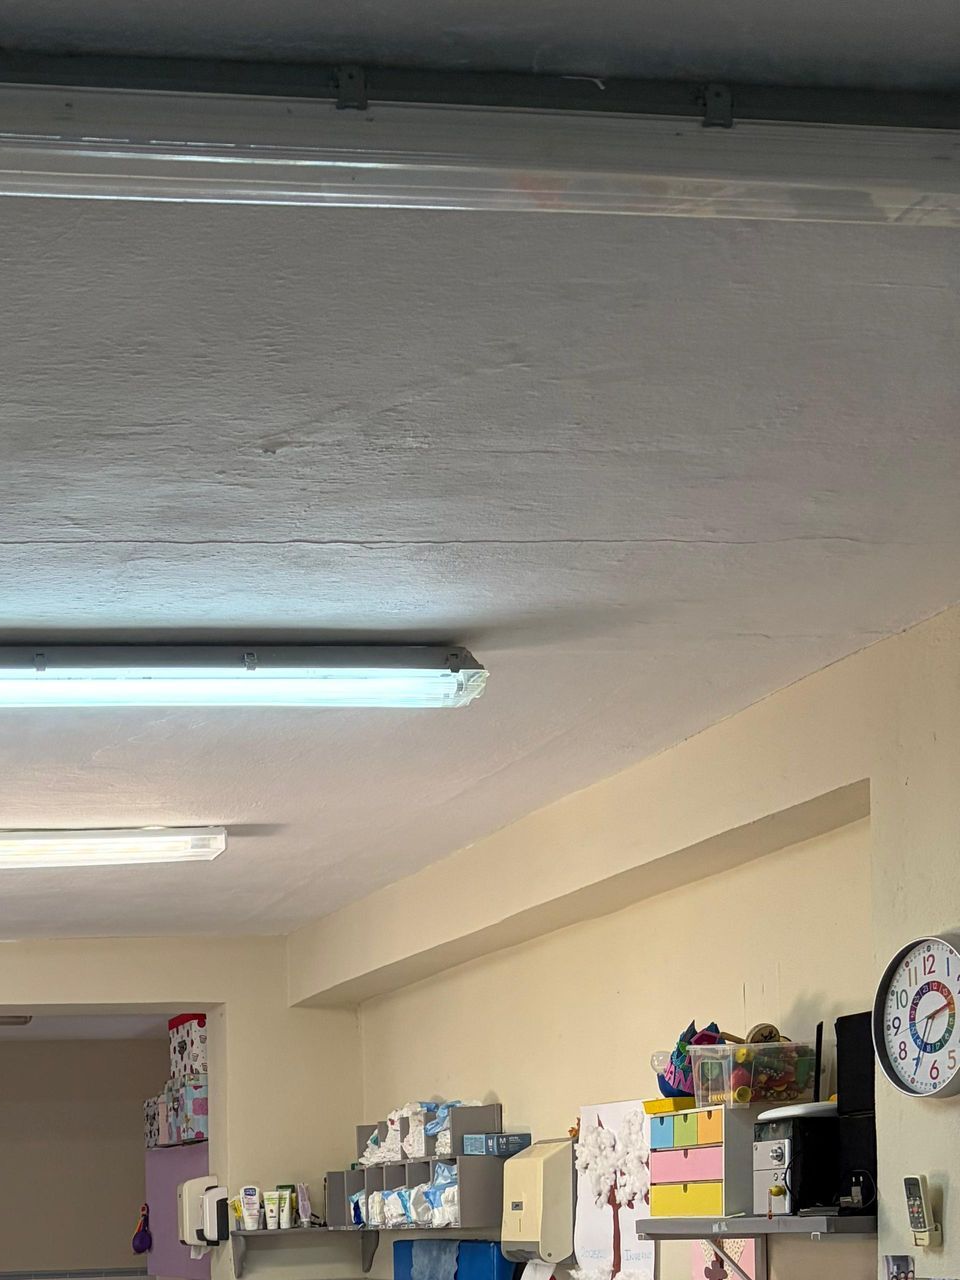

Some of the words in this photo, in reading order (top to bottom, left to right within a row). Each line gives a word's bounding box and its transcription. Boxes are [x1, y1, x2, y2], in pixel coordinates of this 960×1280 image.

[923, 954, 936, 976] 12
[946, 957, 950, 977] 1
[908, 966, 918, 987] 11
[896, 989, 908, 1010] 10
[892, 1016, 901, 1037] 9
[898, 1041, 907, 1061] 8
[947, 1049, 956, 1070] 5
[929, 1059, 940, 1080] 6
